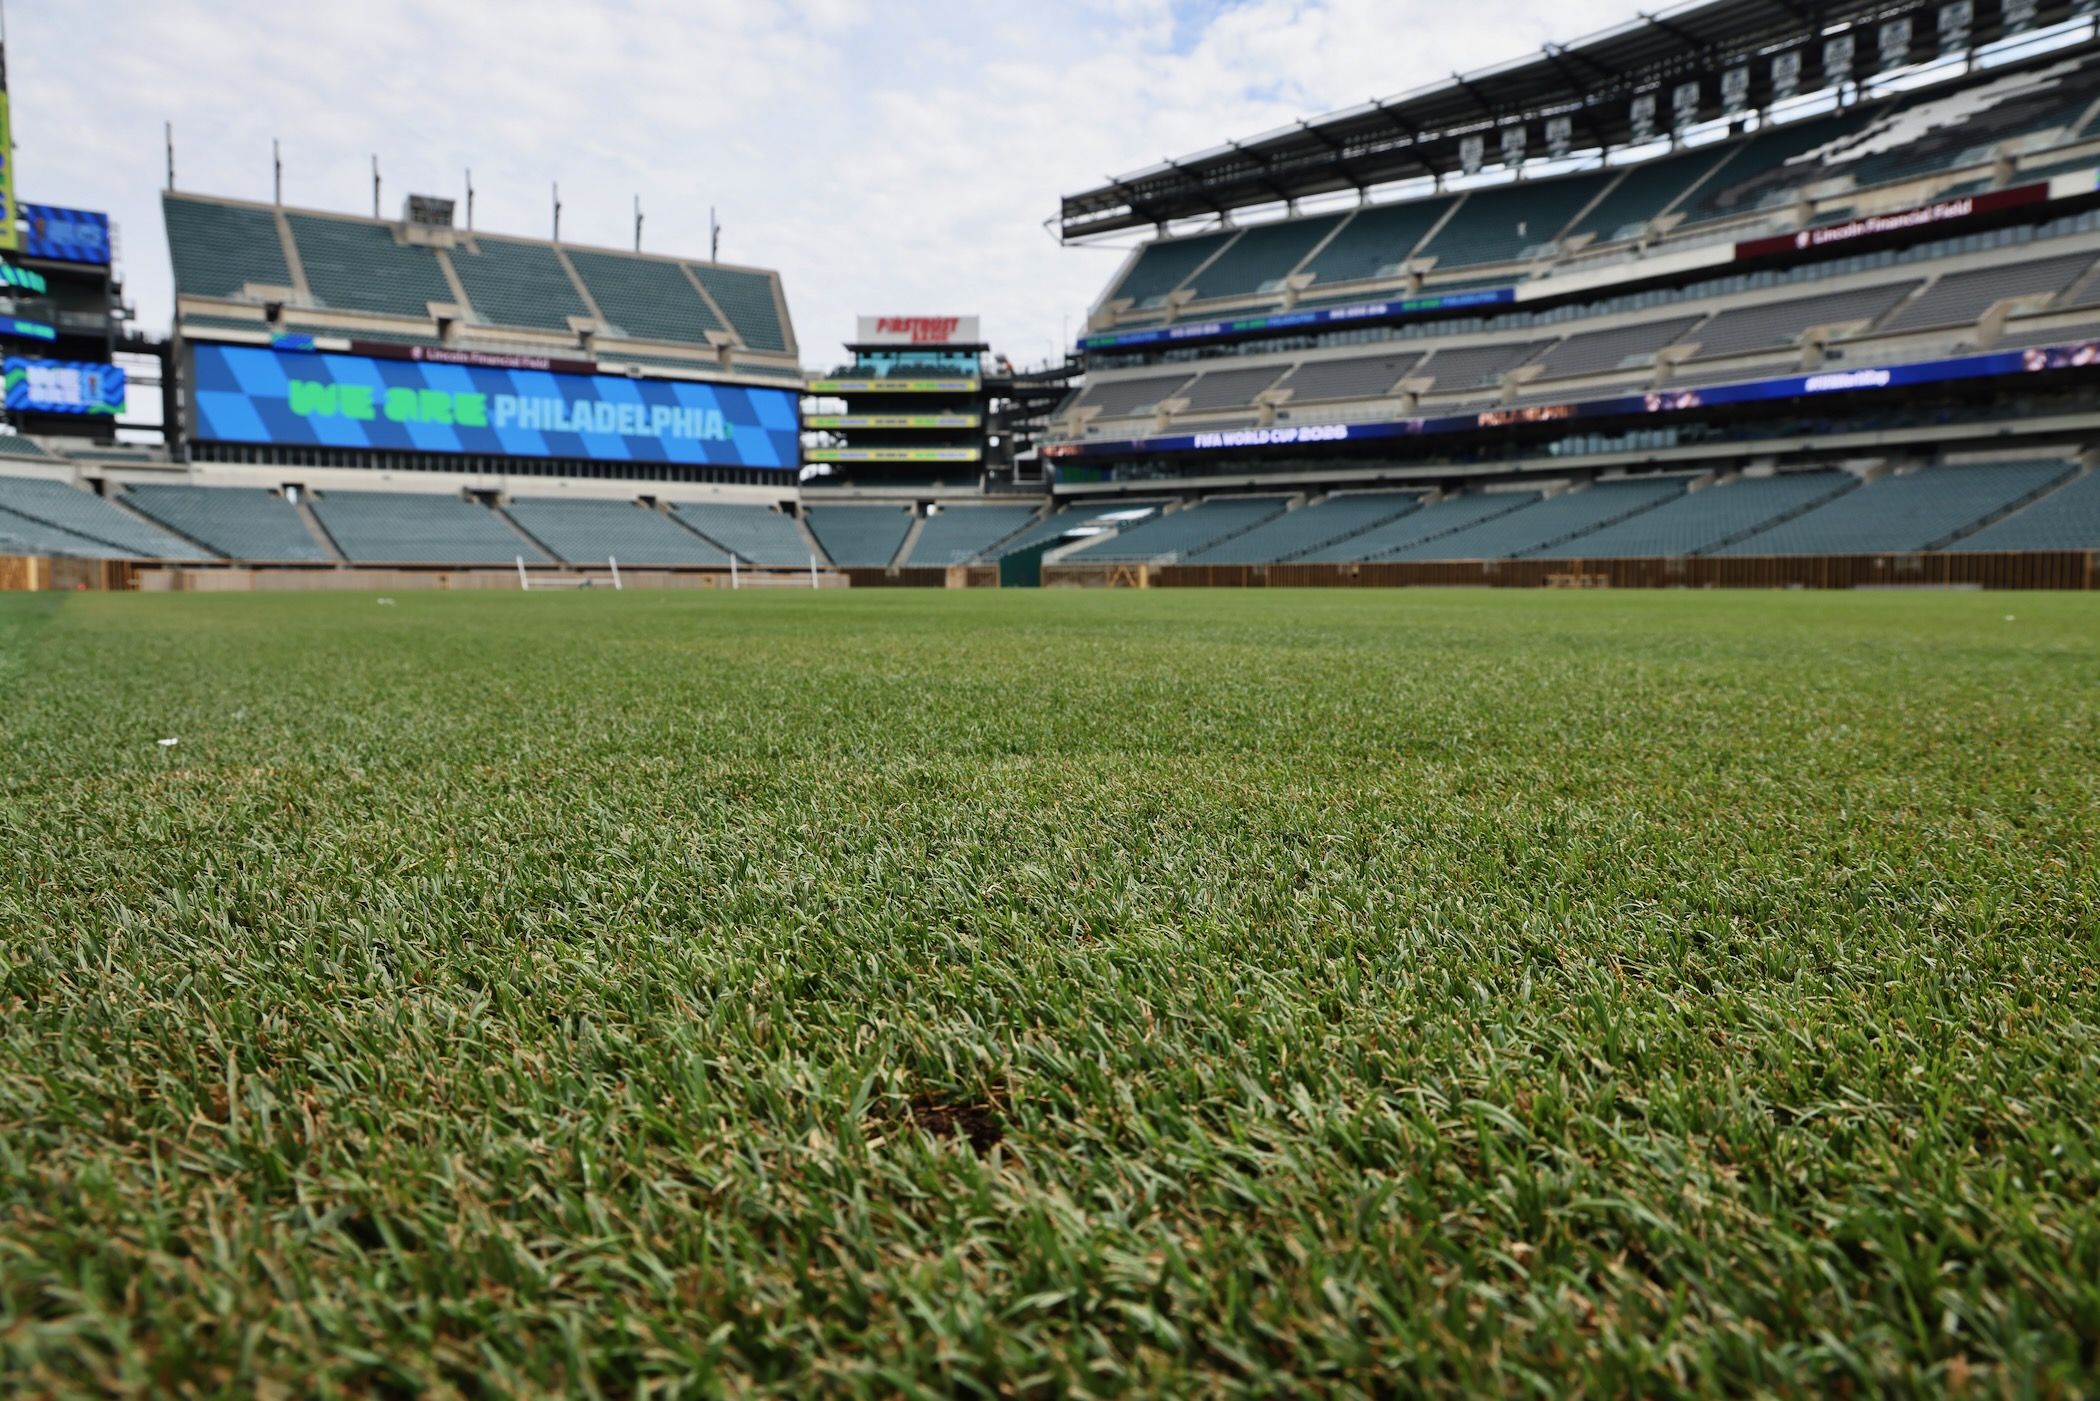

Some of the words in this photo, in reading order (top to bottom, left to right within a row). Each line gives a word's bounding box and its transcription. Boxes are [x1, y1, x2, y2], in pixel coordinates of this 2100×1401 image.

[1813, 223, 1863, 244] Lincoln
[1866, 208, 1930, 231] Financial
[1933, 199, 1973, 218] Field
[426, 348, 469, 362] Lincoln
[470, 351, 520, 368] Financial
[521, 356, 550, 369] Field
[288, 379, 376, 421] WE
[383, 386, 488, 428] ARE
[494, 393, 726, 442] PHILADELPHIA
[1193, 433, 1223, 449] FIFA
[1222, 429, 1271, 448] WORLD
[1269, 427, 1298, 444] CUP
